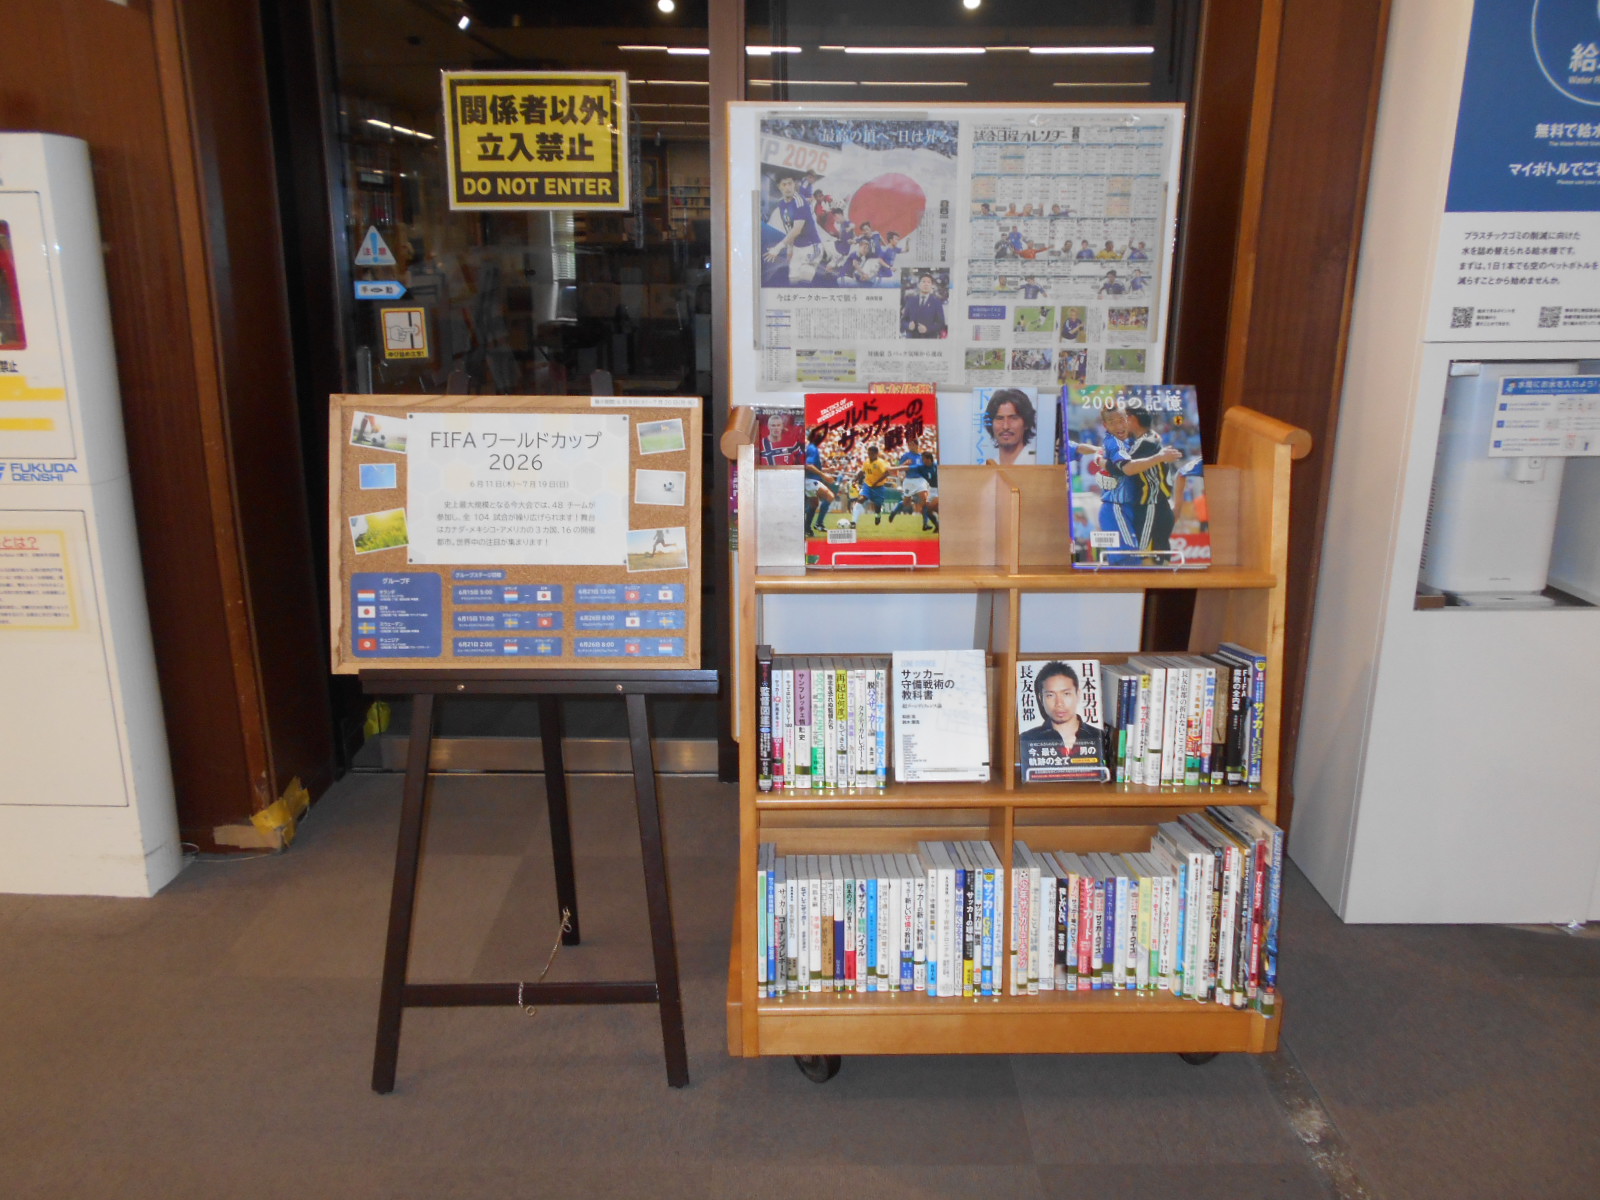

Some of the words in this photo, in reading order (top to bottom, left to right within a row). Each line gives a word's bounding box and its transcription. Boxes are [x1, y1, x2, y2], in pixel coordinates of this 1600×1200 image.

[1568, 42, 1600, 72] 給
[460, 94, 609, 126] 関係者以外
[477, 132, 594, 162] 立入禁止
[783, 144, 830, 172] 2026
[1509, 162, 1600, 177] マイボトルでご
[463, 177, 491, 195] DO
[497, 177, 539, 195] NOT
[544, 177, 612, 196] ENTER
[820, 401, 839, 416] TACTICS
[1081, 395, 1183, 411] 2006の記憶
[809, 398, 879, 444] ワールド
[838, 398, 924, 451] サッカーの
[430, 431, 477, 449] FIFA
[482, 430, 603, 449] ワールドカップ
[10, 463, 78, 473] FUKUDA
[488, 453, 543, 471] 2026
[12, 473, 64, 482] DENSHI
[901, 669, 944, 679] サッカー
[1240, 669, 1248, 697] FIFA
[901, 680, 955, 690] 守備戦術の
[1020, 665, 1036, 722] 長友佑都
[1081, 663, 1099, 723] 日本男児
[901, 690, 934, 700] 教科書
